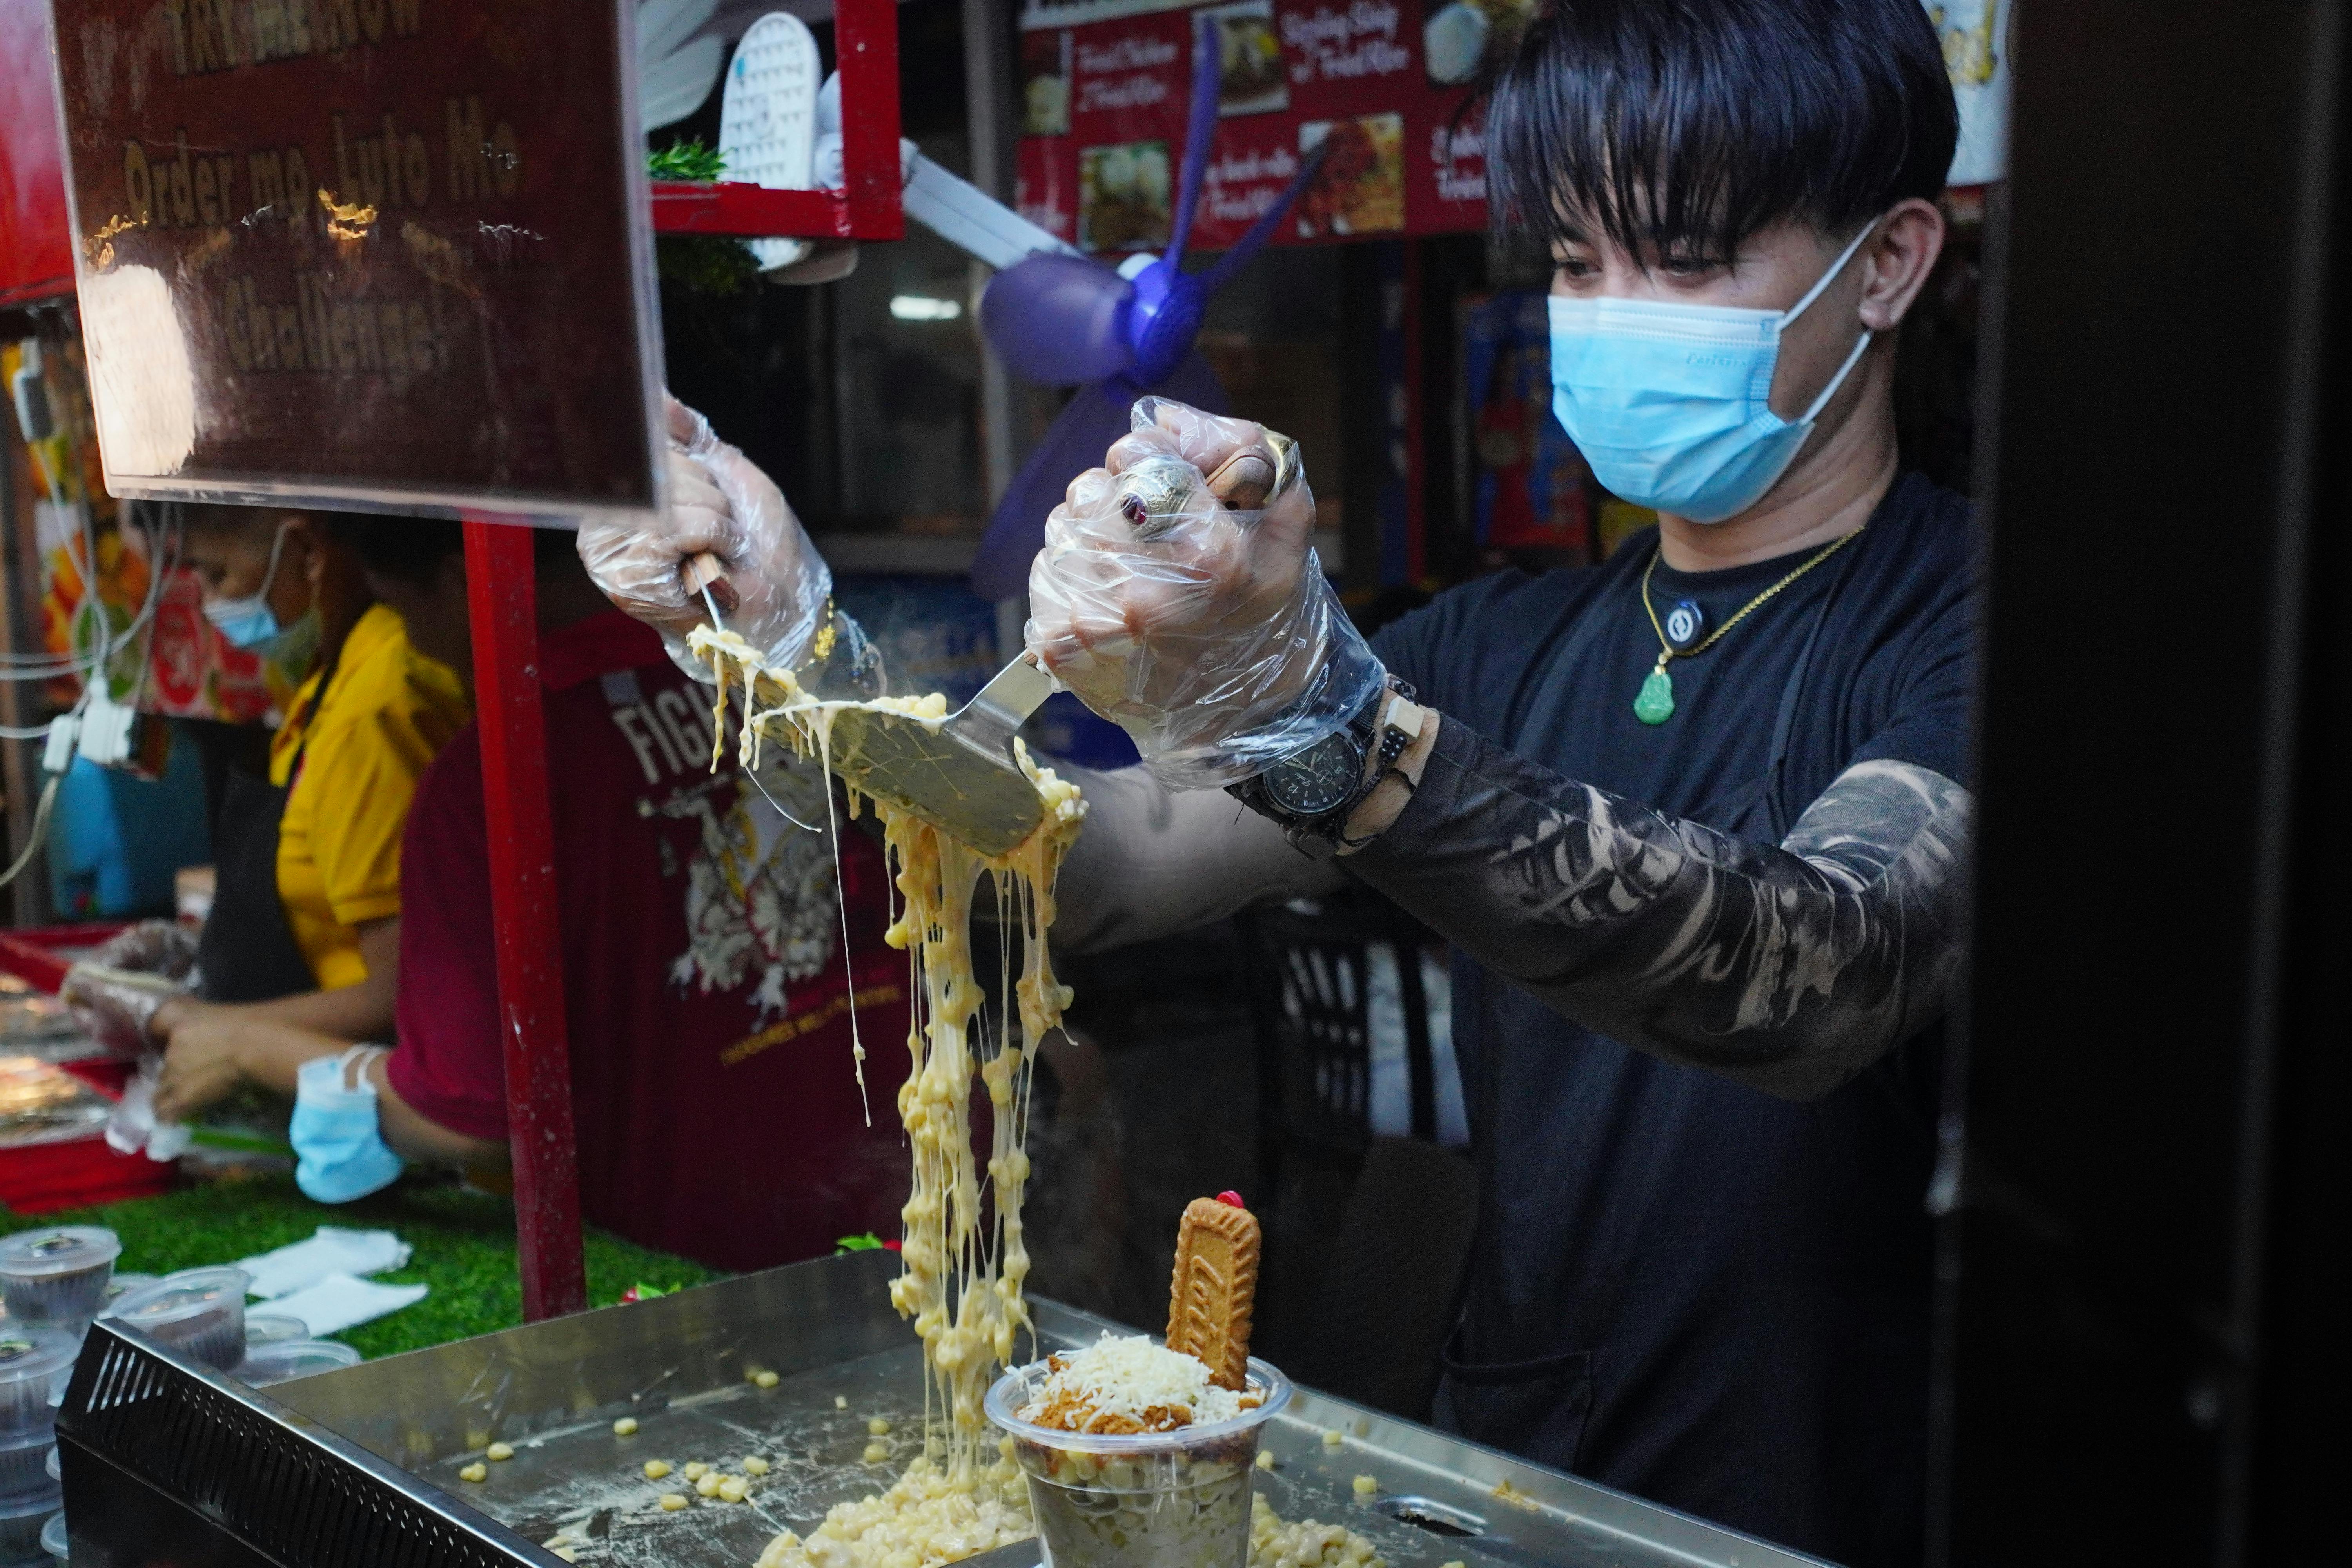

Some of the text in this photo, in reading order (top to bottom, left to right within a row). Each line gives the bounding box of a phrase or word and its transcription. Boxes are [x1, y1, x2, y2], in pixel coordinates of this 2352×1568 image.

[123, 129, 233, 227] Order
[249, 146, 310, 216] mo
[332, 111, 428, 210] Luto
[1288, 783, 1298, 794] 12
